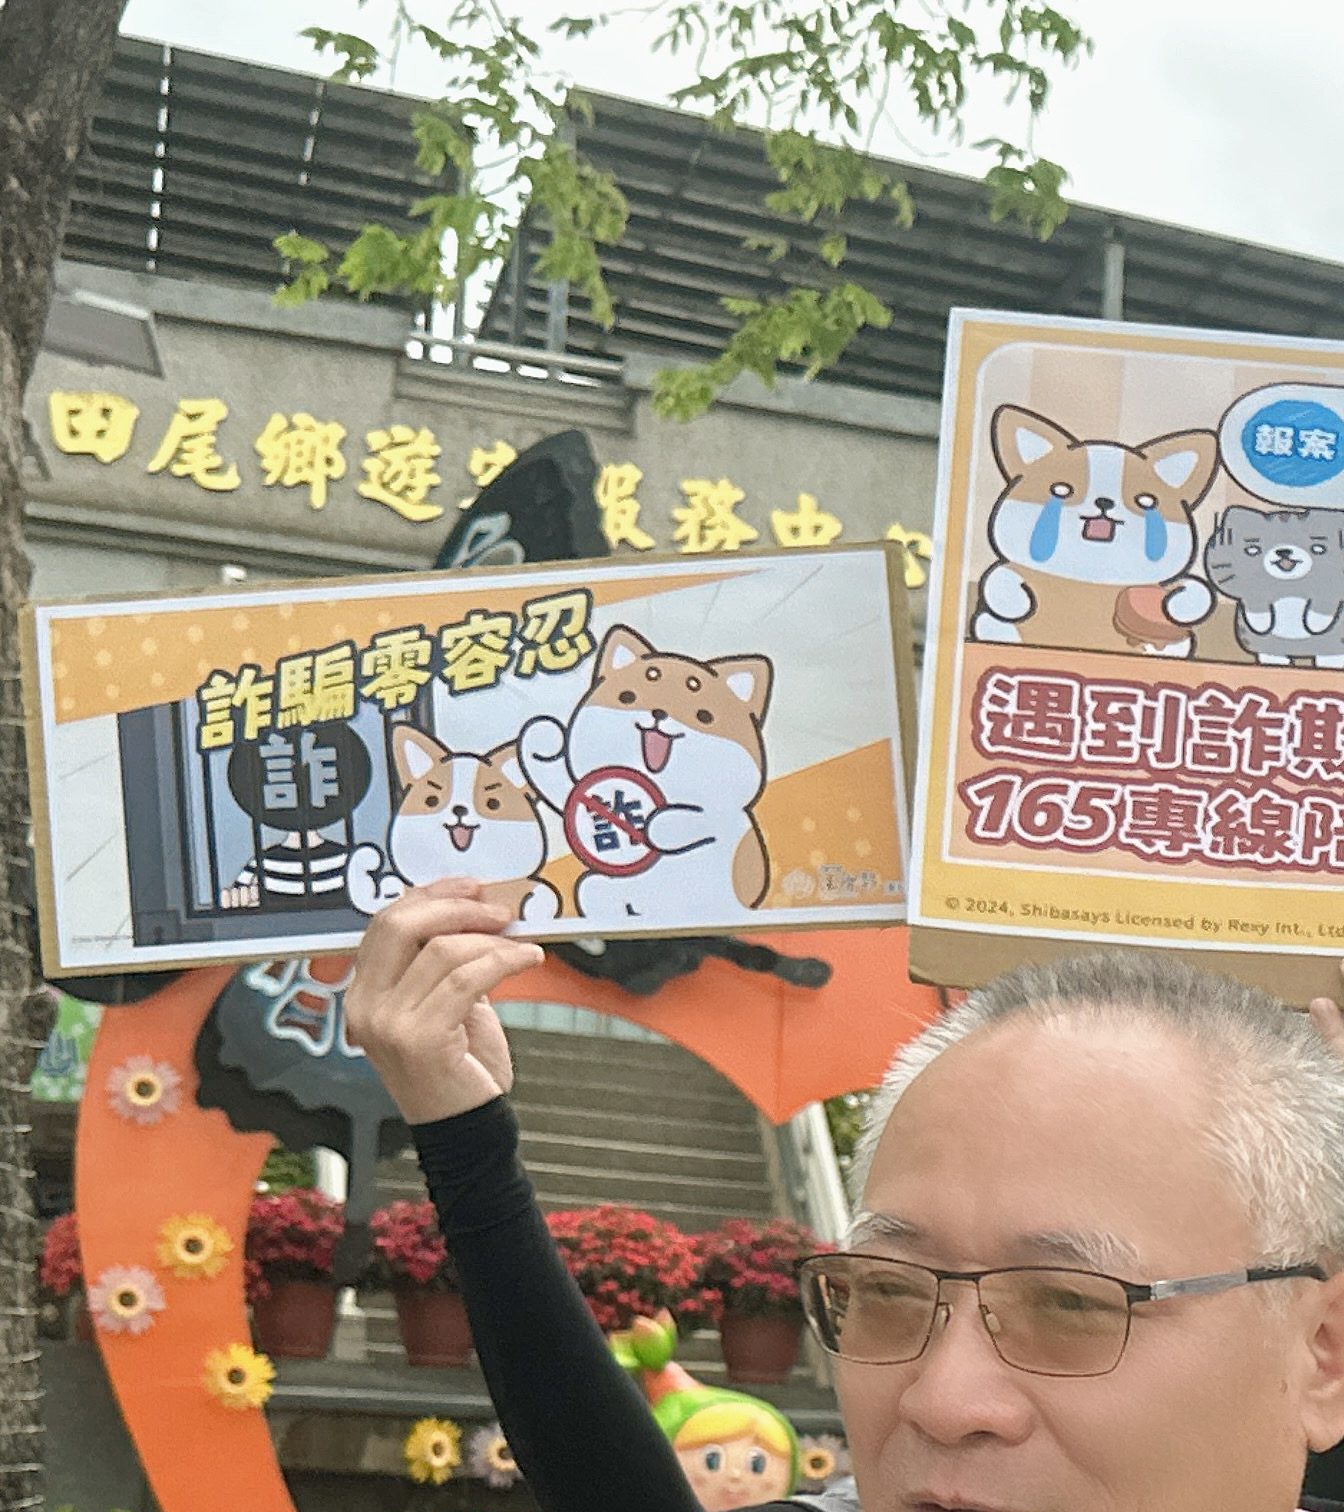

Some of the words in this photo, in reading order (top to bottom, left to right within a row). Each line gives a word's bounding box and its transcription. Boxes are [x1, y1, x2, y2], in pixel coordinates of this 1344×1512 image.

[1255, 423, 1338, 461] 報案
[48, 390, 933, 590] 田尾鄉遊服務中
[196, 586, 598, 753] 詐騙零容忍
[260, 733, 340, 813] 詐
[1115, 911, 1195, 930] Licensed
[1201, 917, 1223, 934] by
